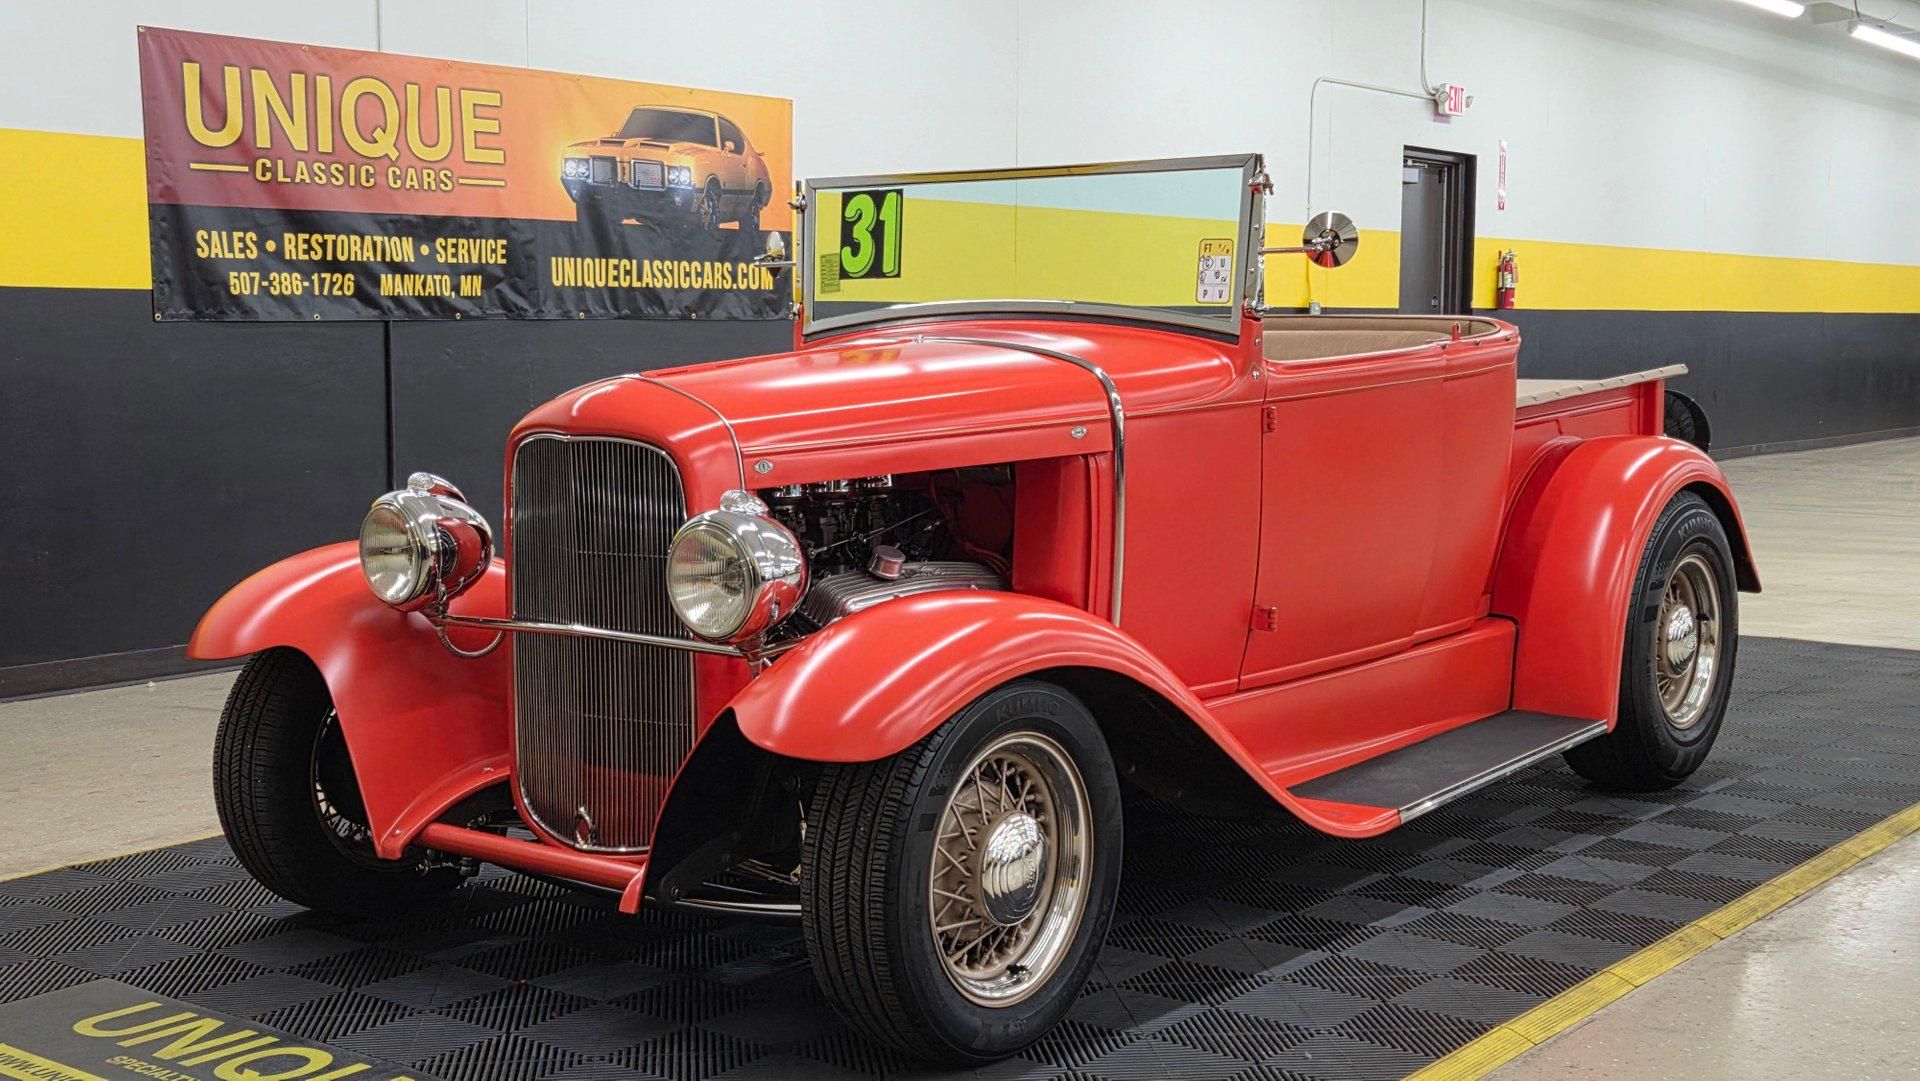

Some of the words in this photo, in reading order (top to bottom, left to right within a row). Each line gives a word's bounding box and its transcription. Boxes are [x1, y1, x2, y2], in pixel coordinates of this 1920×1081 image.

[182, 62, 505, 165] UNIQUE
[1448, 85, 1464, 114] EXIT
[255, 158, 375, 187] CLASSIC
[388, 167, 453, 191] CARS
[196, 230, 258, 259] SALES
[283, 232, 415, 263] RESTORATION
[435, 237, 507, 264] SERVICE
[841, 191, 902, 278] 31
[229, 271, 355, 296] 507-386-1726
[380, 273, 455, 299] MANKATO,
[460, 275, 483, 297] MN
[551, 256, 774, 290] UNIQUECLASSICCARS.COM
[73, 1001, 416, 1081] UNIQ
[104, 1055, 203, 1081] SPECIALT
